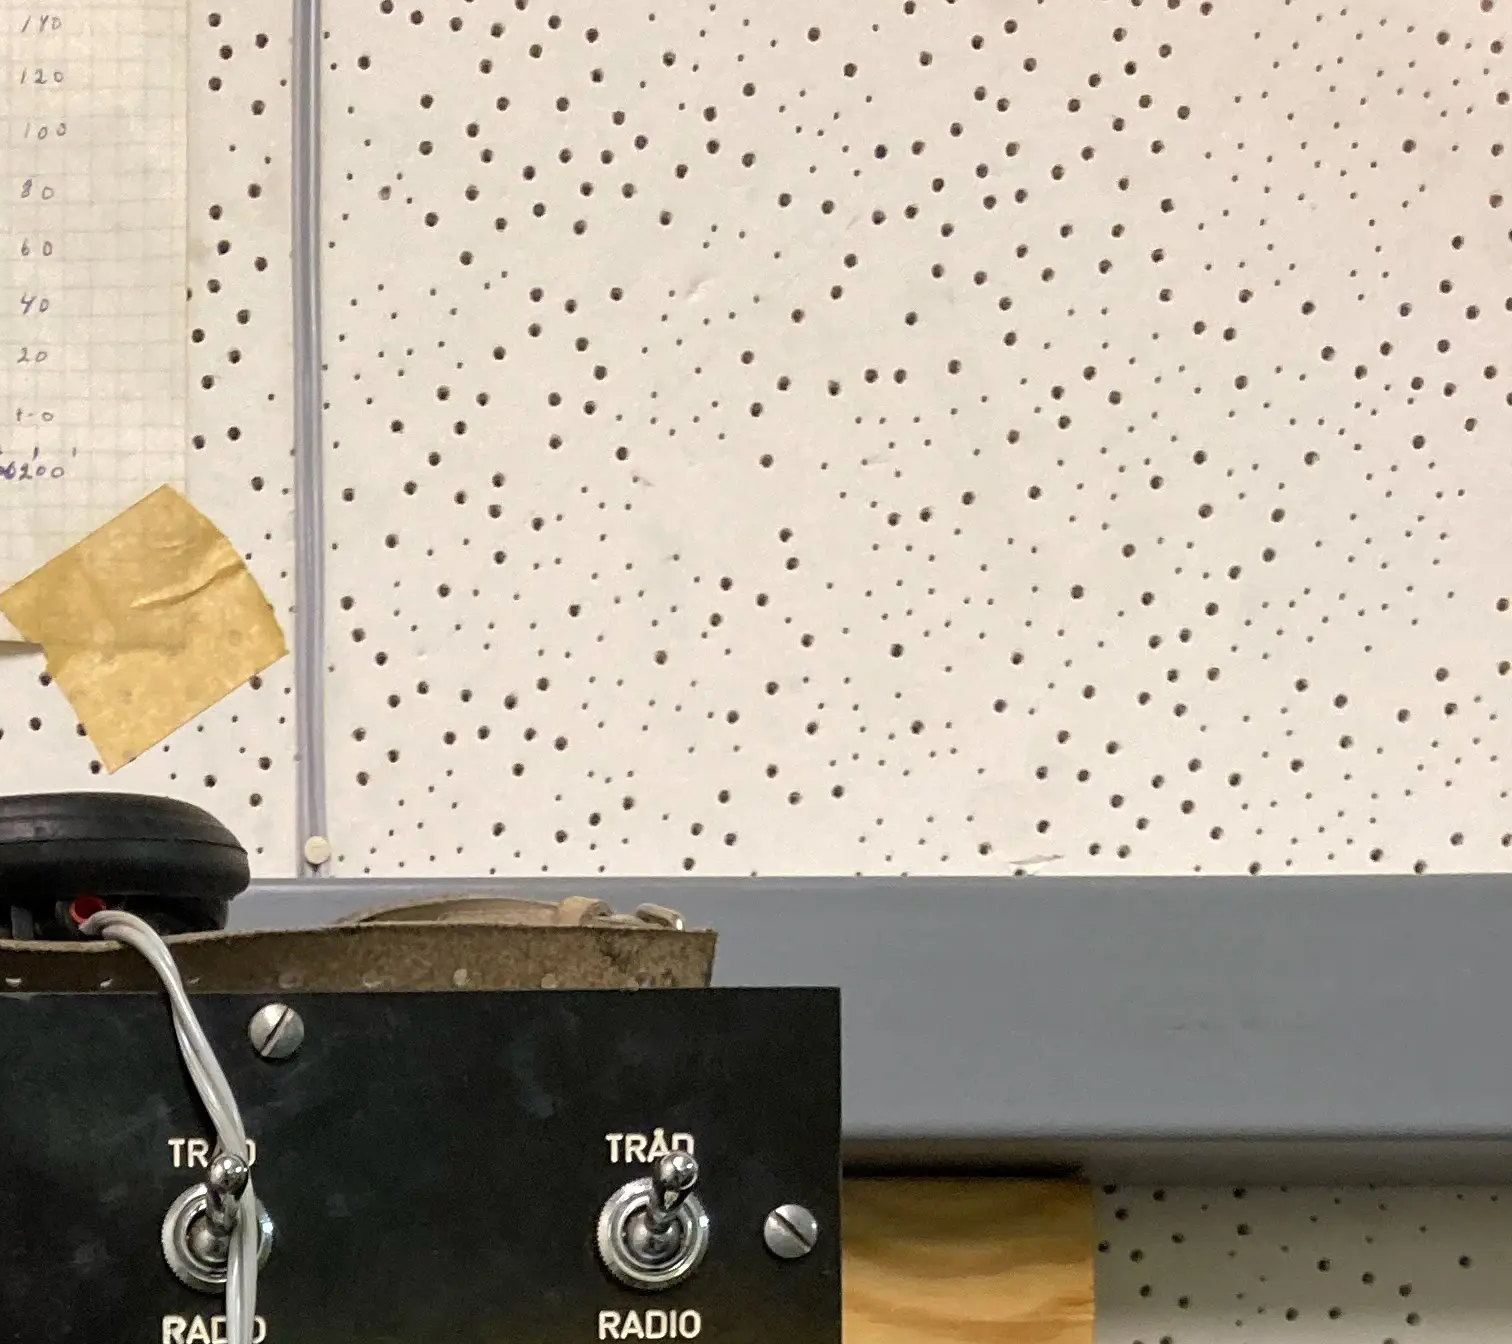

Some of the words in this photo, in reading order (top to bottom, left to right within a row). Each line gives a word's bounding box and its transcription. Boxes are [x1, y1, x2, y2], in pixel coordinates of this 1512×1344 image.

[21, 15, 62, 33] 140
[20, 68, 64, 85] 120
[24, 122, 67, 140] 100
[20, 179, 54, 200] 80
[21, 238, 53, 256] 60
[20, 292, 50, 315] 40
[17, 347, 48, 363] 20
[605, 1127, 695, 1163] TRÅD
[597, 1309, 702, 1342] RADIO
